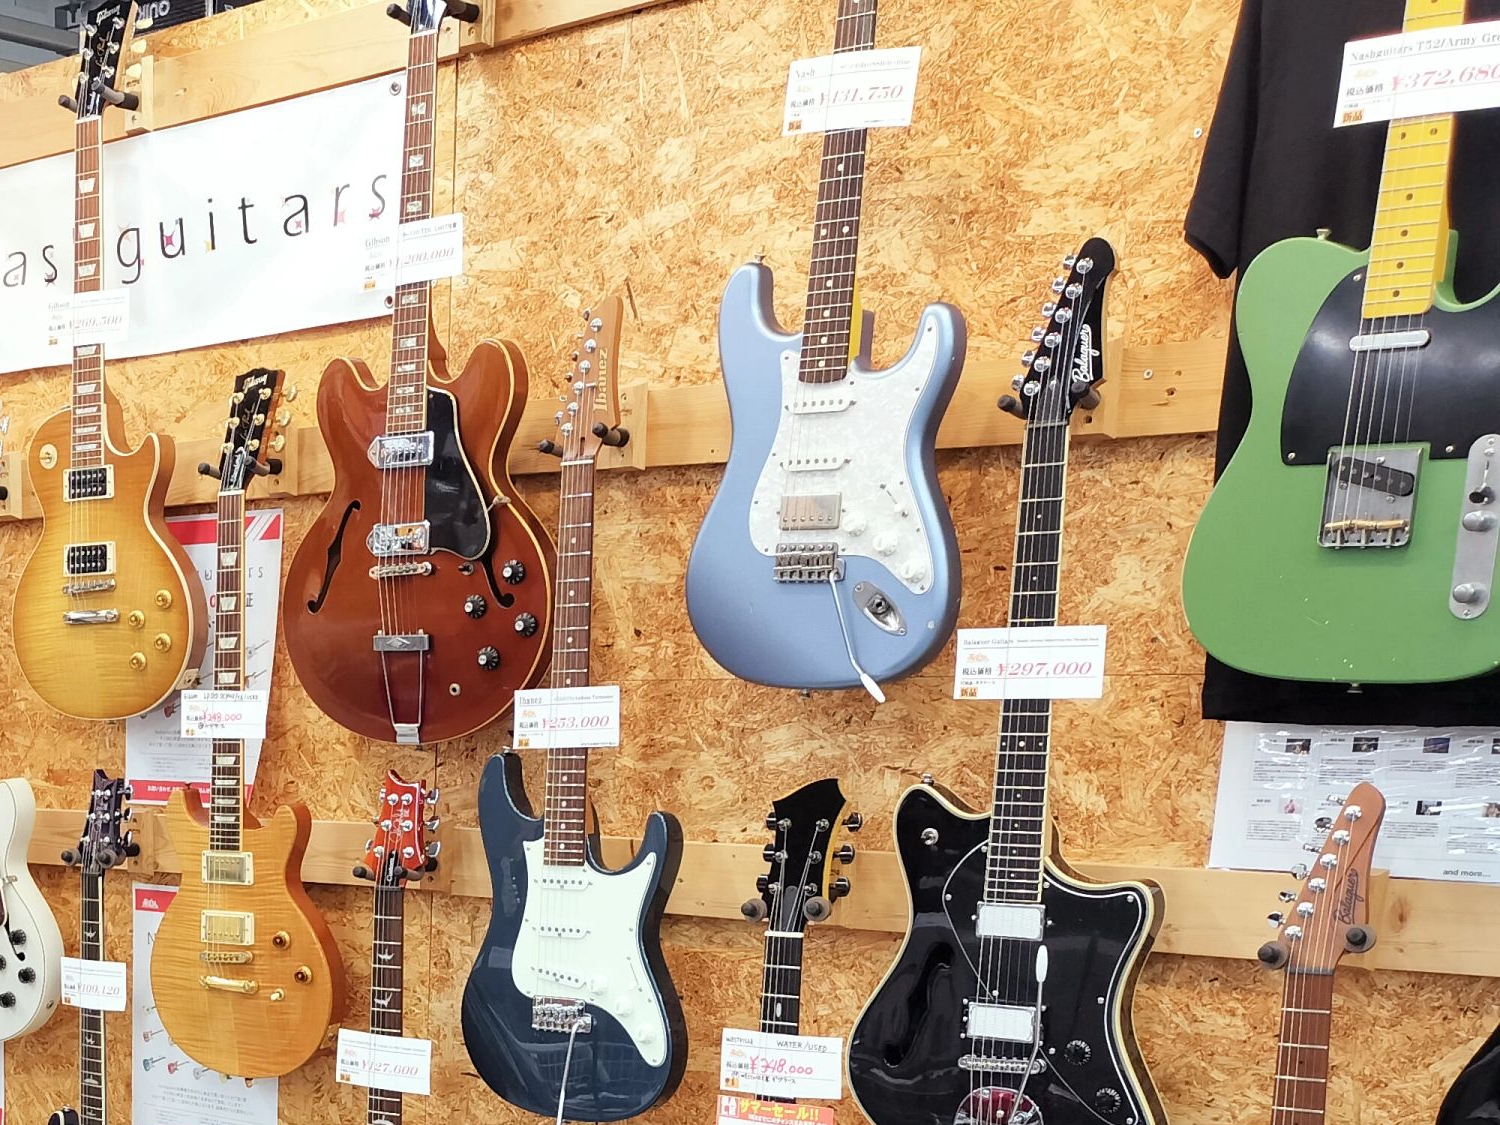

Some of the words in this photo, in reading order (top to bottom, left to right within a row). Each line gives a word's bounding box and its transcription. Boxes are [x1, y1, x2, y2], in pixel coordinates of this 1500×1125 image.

[1351, 43, 1413, 61] Nashguitars
[1416, 33, 1478, 53] T52/Army
[1346, 82, 1384, 98] 税込価格
[115, 172, 388, 285] guitars
[1072, 323, 1100, 383] Balaguer
[243, 373, 268, 393] Gibson
[593, 347, 608, 412] Ibanez
[962, 667, 992, 676] 税込価格
[996, 661, 1092, 678] ¥297,000
[542, 715, 609, 730] ¥253,000
[1443, 869, 1463, 878] and
[776, 1039, 828, 1053] WATER/USED
[739, 1099, 819, 1121] サマーセール!!
